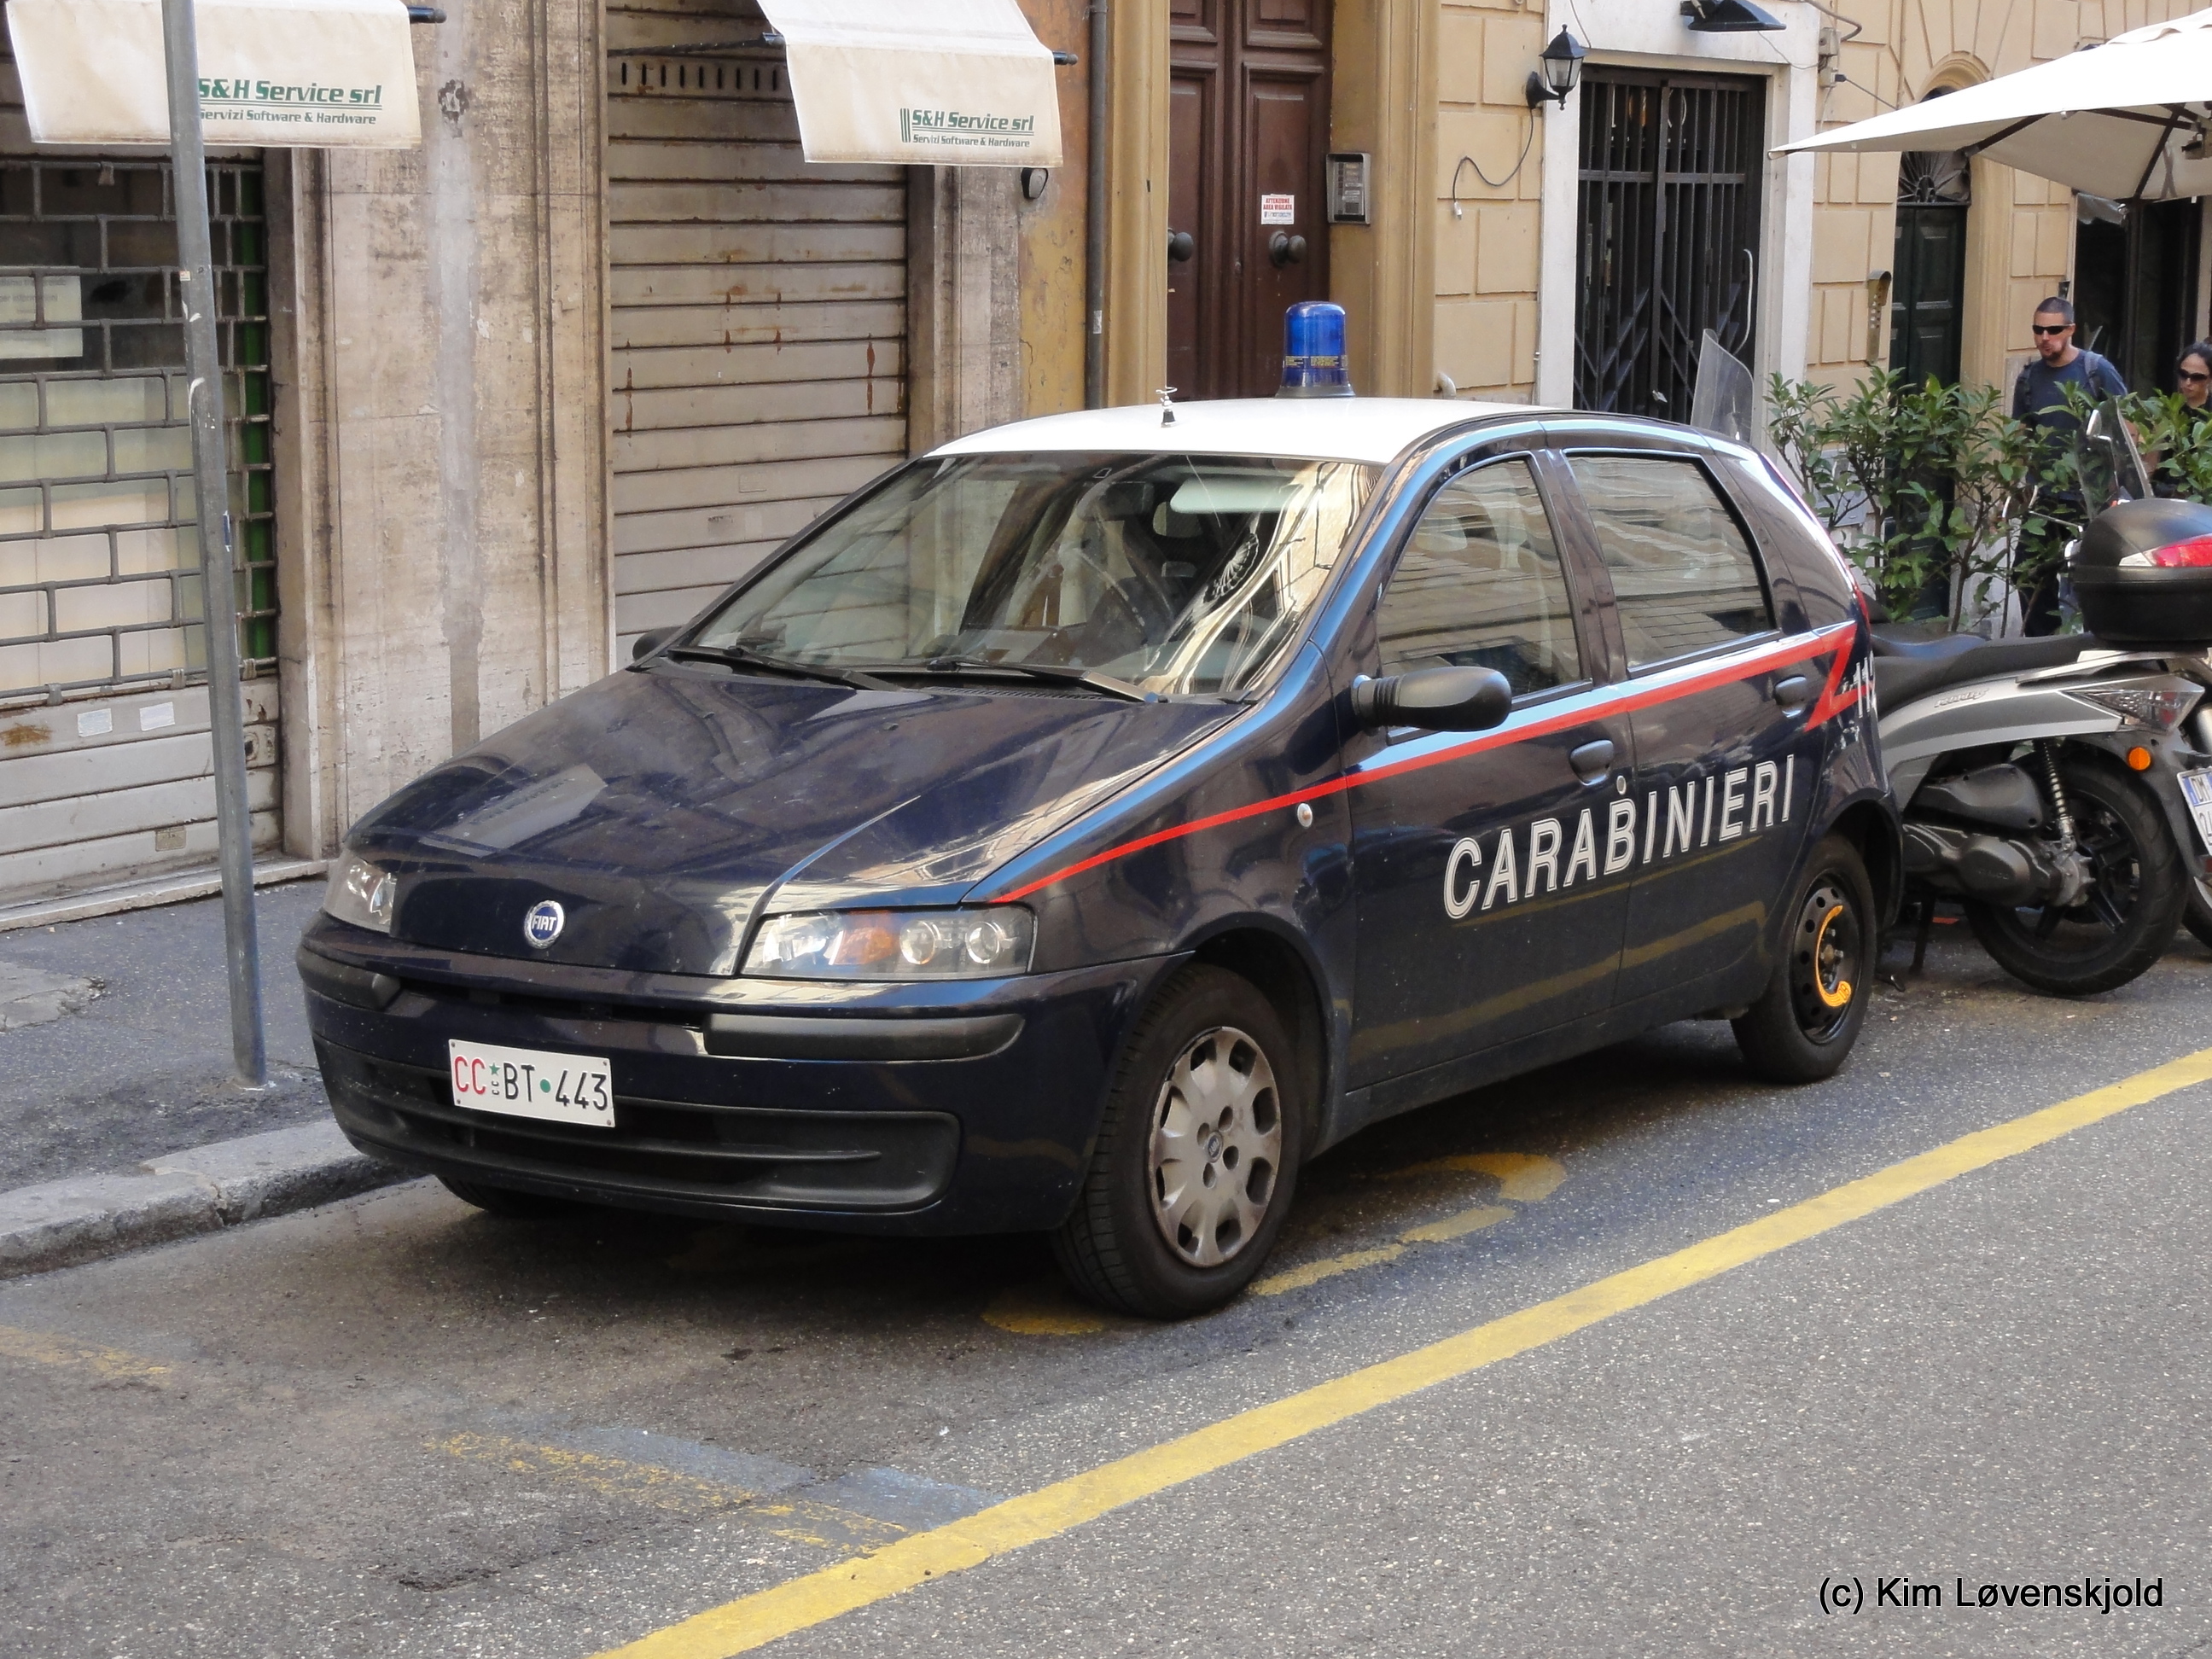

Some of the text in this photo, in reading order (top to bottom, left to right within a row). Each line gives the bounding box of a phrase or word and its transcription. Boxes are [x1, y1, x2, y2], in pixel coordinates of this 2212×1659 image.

[199, 78, 382, 104] S&H Service srl
[246, 109, 301, 122] Software
[304, 112, 313, 123] &
[316, 113, 376, 125] Hardware
[912, 109, 1034, 131] S&H Service srl
[913, 134, 1030, 148] Servizi Software & Hardware
[1443, 754, 1794, 919] CARABINIERI
[531, 915, 557, 932] FIAT
[454, 1056, 486, 1095] CC
[503, 1062, 535, 1103] BT
[556, 1070, 608, 1111] 443
